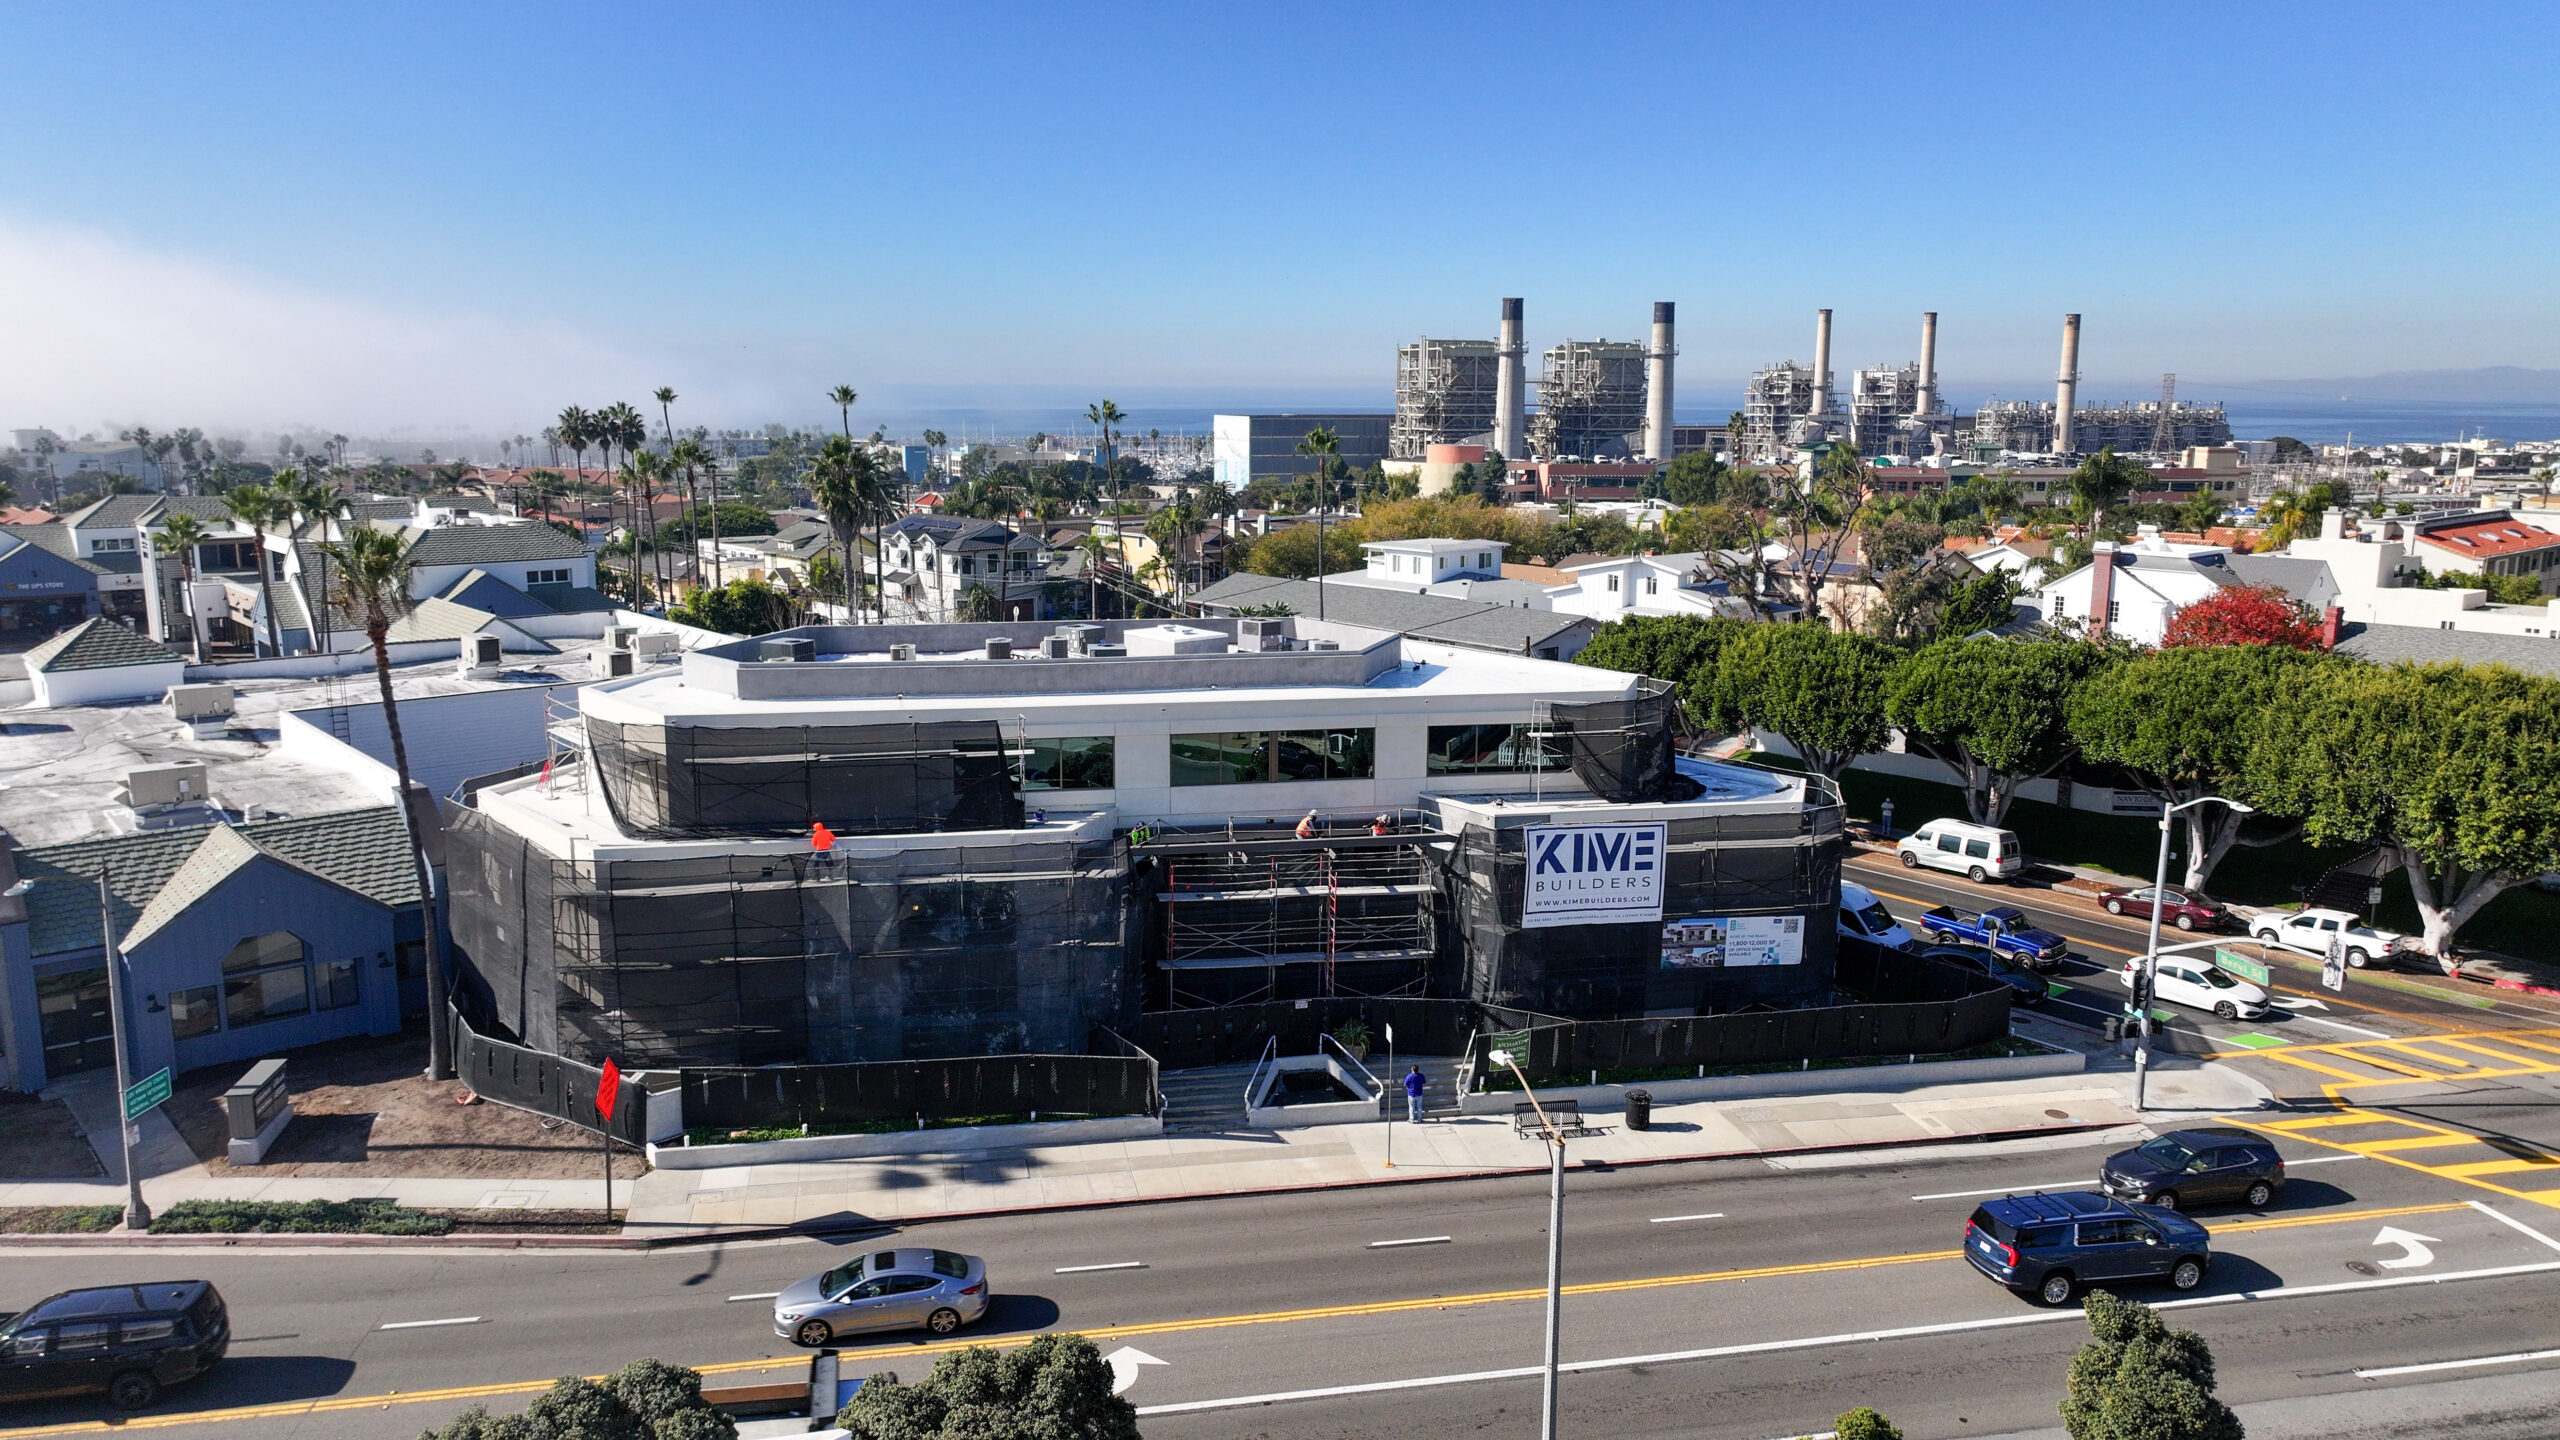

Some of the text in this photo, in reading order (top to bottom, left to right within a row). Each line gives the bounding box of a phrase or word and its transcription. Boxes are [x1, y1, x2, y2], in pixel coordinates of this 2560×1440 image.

[1535, 831, 1655, 875] KIME
[1535, 876, 1651, 892] BUILDERS
[1535, 896, 1650, 906] WWW.KIMEBUILDERS.COM
[2251, 967, 2263, 979] St
